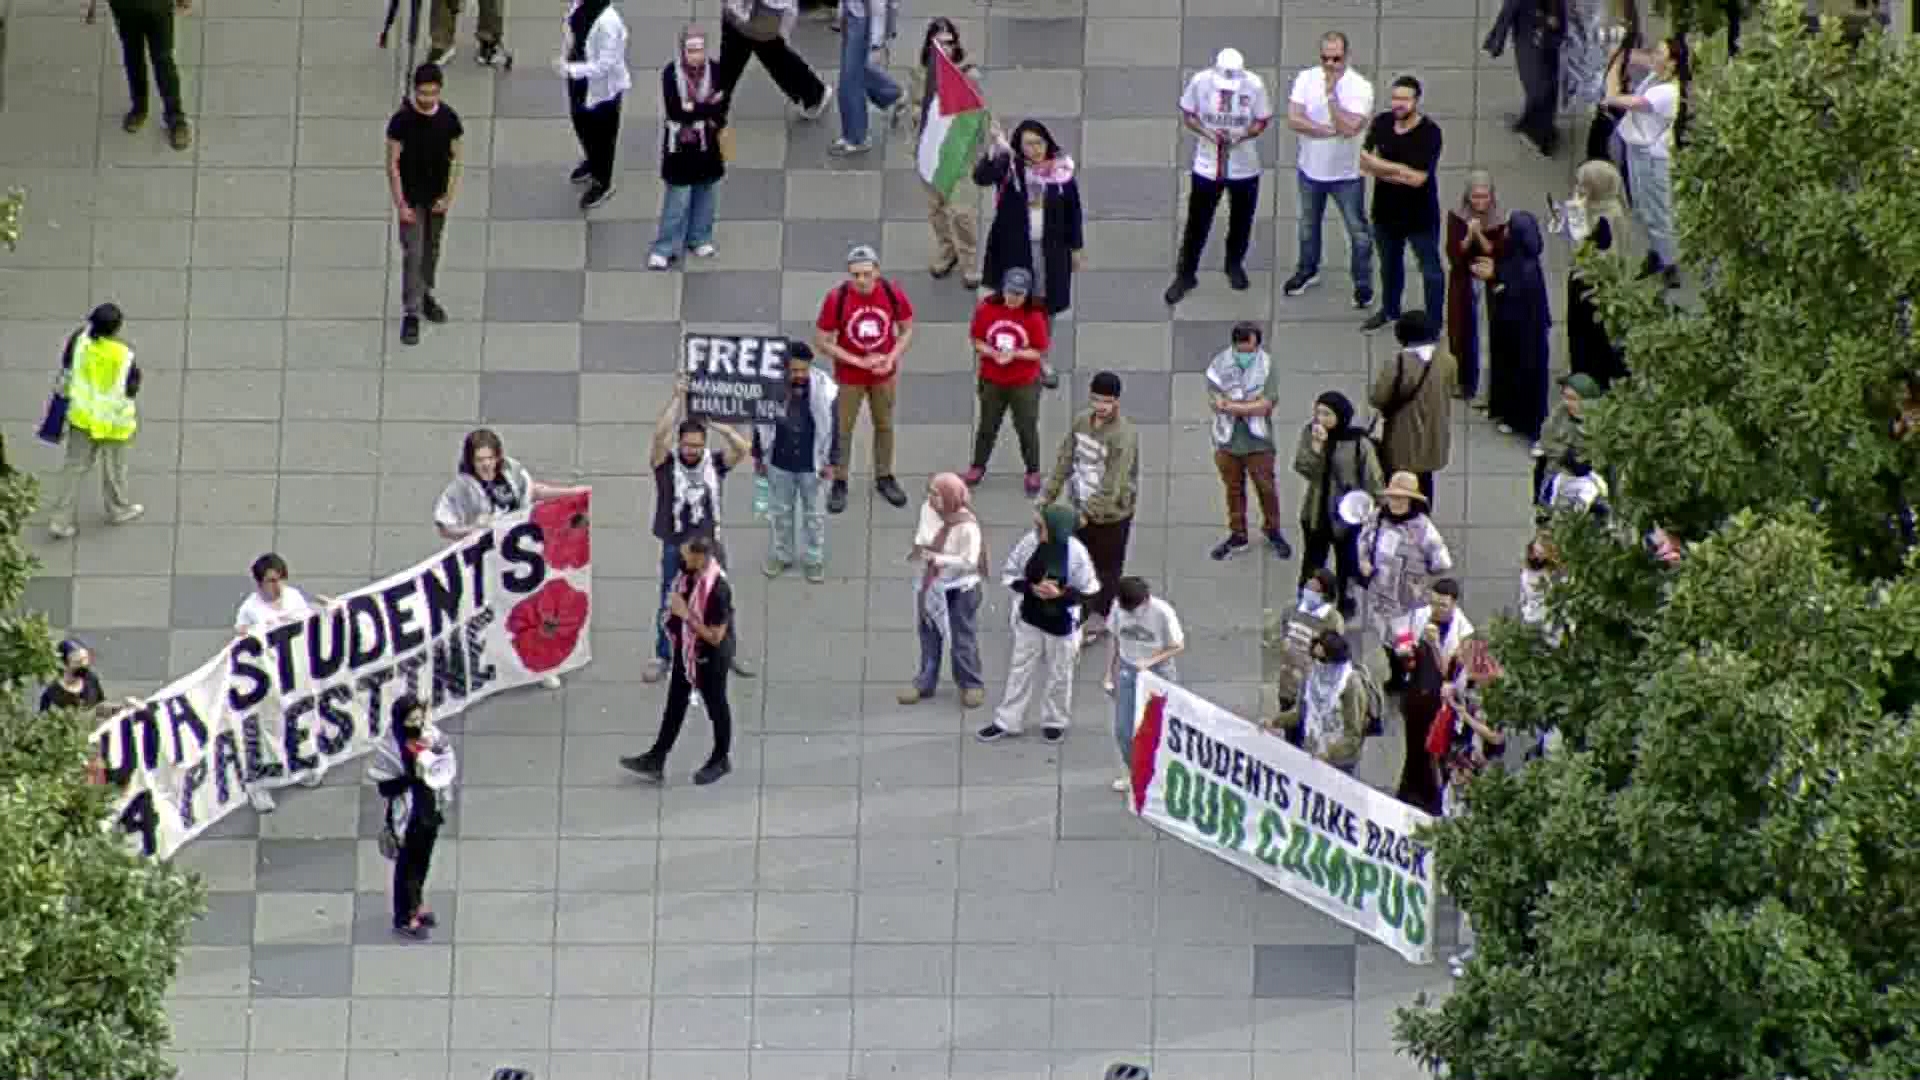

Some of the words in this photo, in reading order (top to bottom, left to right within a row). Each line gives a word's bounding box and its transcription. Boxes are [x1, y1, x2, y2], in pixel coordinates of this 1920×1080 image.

[687, 337, 786, 379] FREE
[99, 694, 209, 787] UTA
[228, 523, 546, 712] STUDENTS
[118, 787, 161, 858] 4
[179, 606, 496, 830] PALESTINE
[1165, 759, 1248, 852] OUR
[1254, 809, 1427, 946] CAMPUS
[1166, 716, 1291, 811] STUDENTS
[1298, 783, 1359, 849] TAKE
[1363, 819, 1428, 882] BACK
